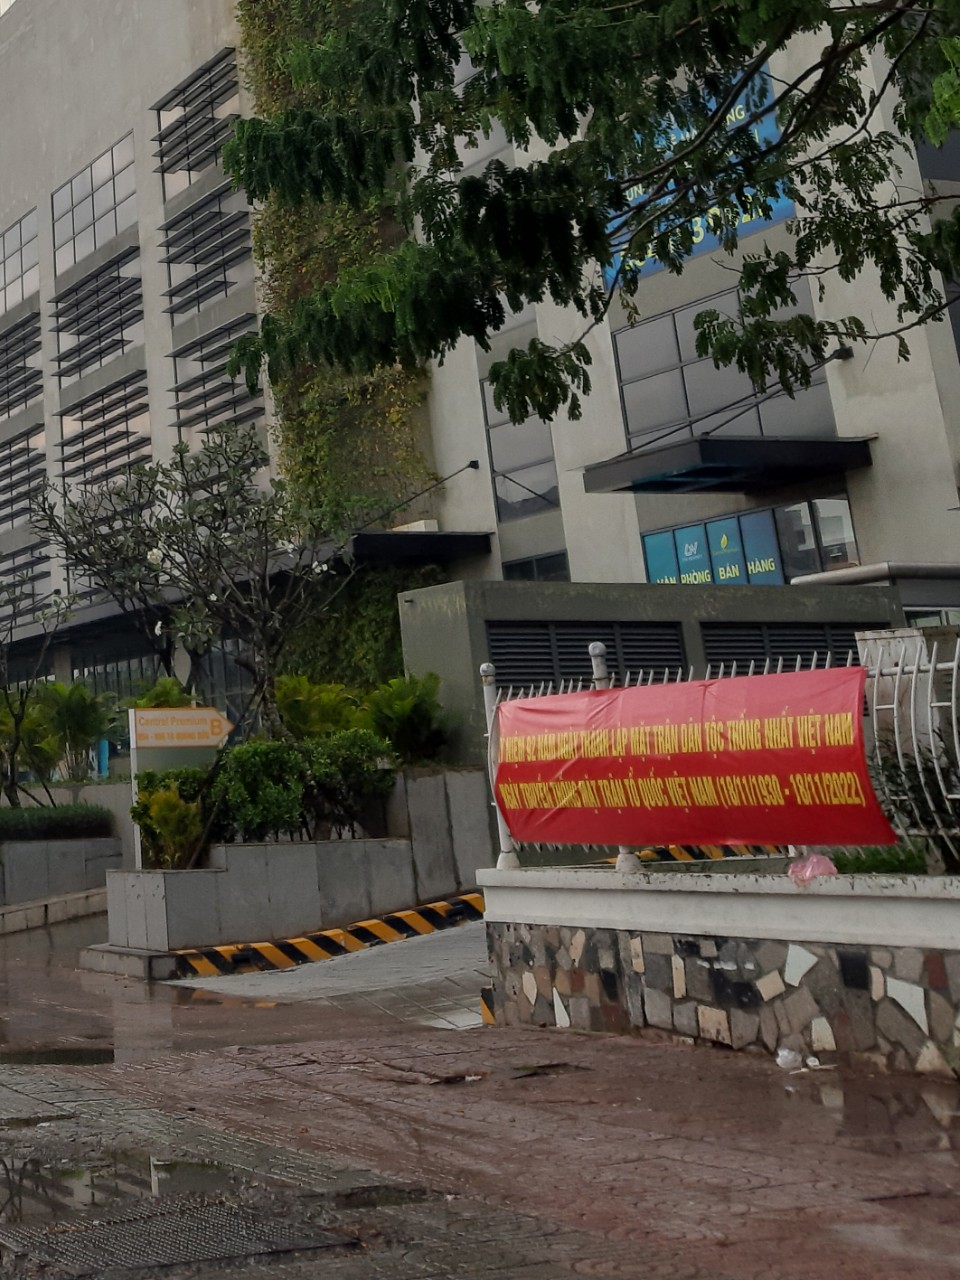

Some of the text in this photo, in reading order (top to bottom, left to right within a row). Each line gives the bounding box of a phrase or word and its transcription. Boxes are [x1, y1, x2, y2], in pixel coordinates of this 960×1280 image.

[680, 568, 712, 585] PHÒNG
[718, 562, 740, 580] BÁN
[746, 557, 776, 575] HÀNG
[210, 718, 223, 736] B
[526, 735, 537, 762] 92
[557, 726, 578, 760] NGÀY
[630, 721, 651, 762] MẶT
[653, 718, 679, 761] TRẬN
[681, 717, 702, 753] DÂN
[704, 715, 725, 759] TỘC
[726, 708, 762, 752] THỐNG
[764, 705, 794, 749] NHẤT
[796, 708, 821, 755] VIỆT
[824, 712, 854, 746] NAM
[597, 773, 628, 814] TRẬN
[623, 766, 641, 808] TỔ
[638, 766, 669, 811] QUỐC
[664, 770, 692, 813] VIỆT
[688, 776, 720, 807] NAM
[716, 774, 785, 809] (18/11/1930
[790, 771, 866, 808] 18/11/2022)
